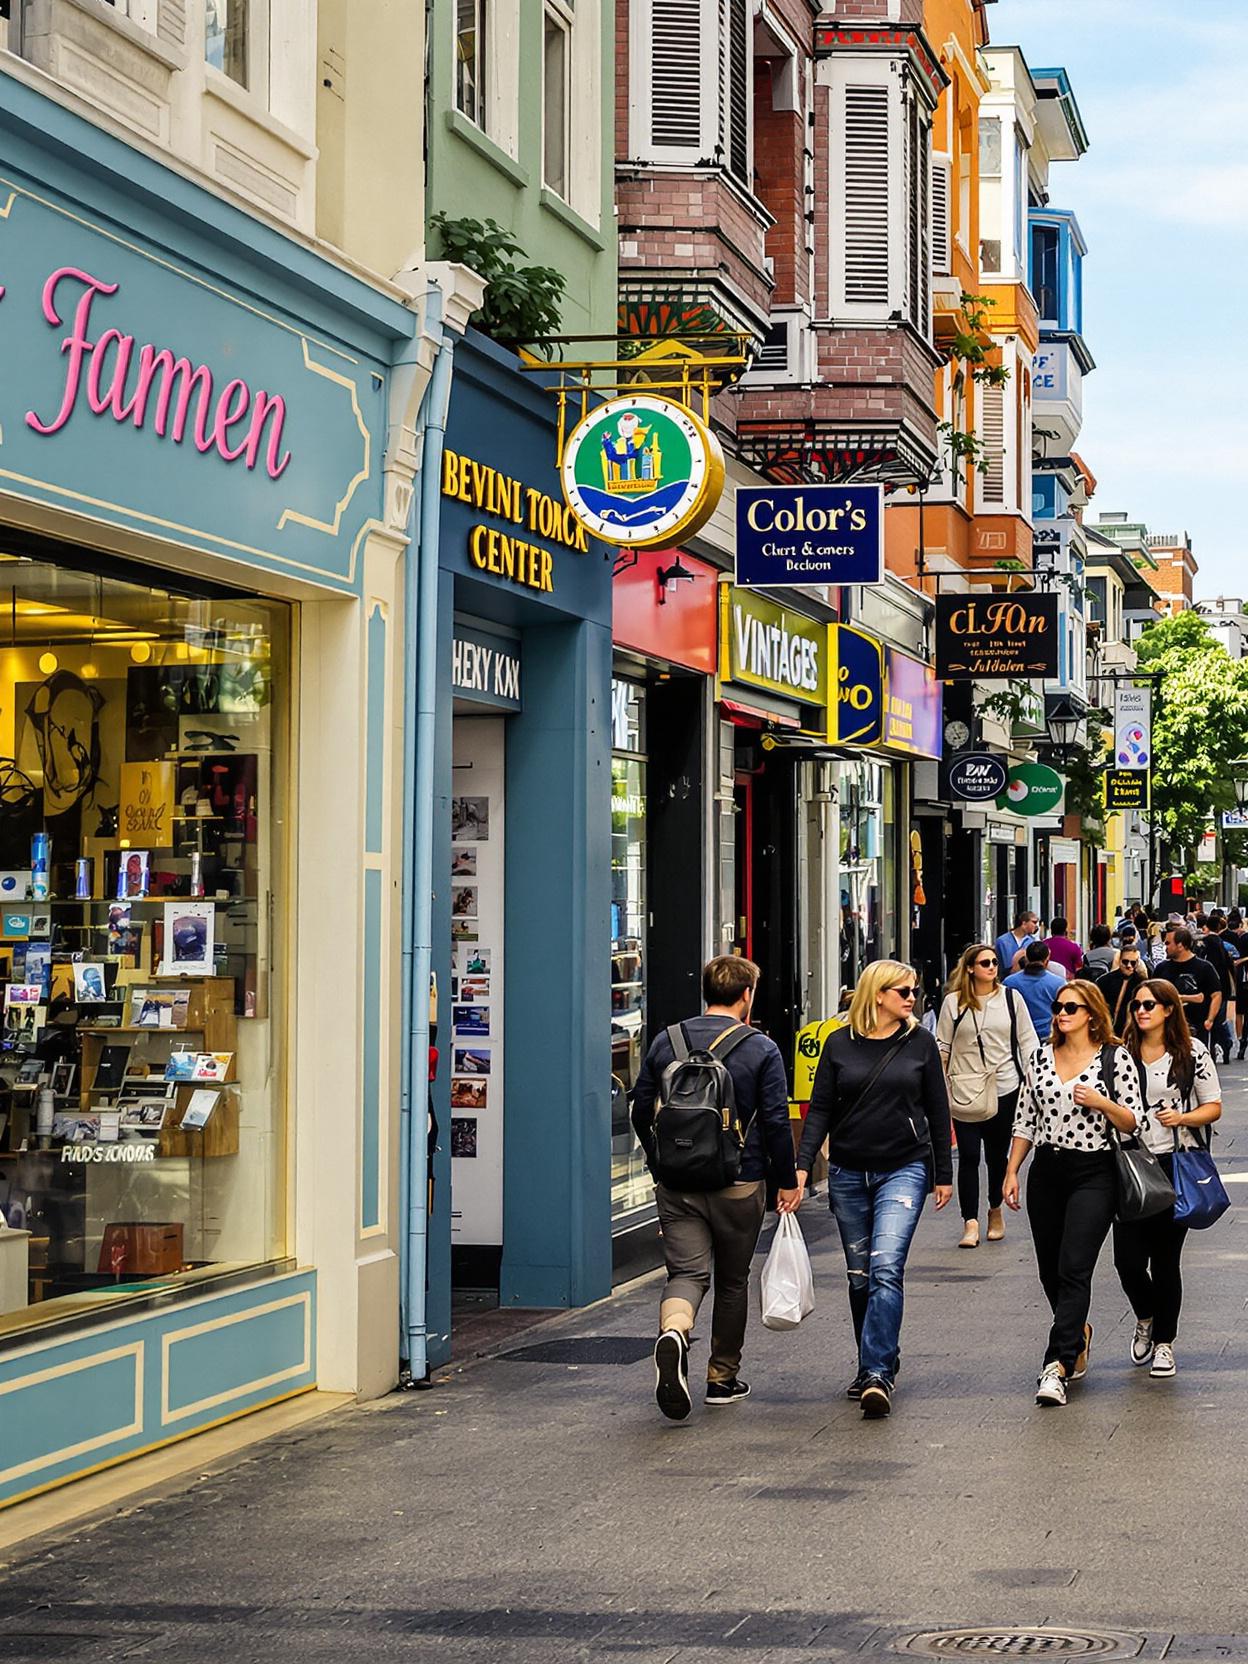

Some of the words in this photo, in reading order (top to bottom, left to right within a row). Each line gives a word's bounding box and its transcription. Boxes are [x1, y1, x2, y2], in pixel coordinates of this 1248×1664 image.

[747, 496, 867, 532] Color's
[470, 525, 554, 593] CENTER
[801, 541, 815, 556] &
[734, 604, 818, 692] VINTAGES
